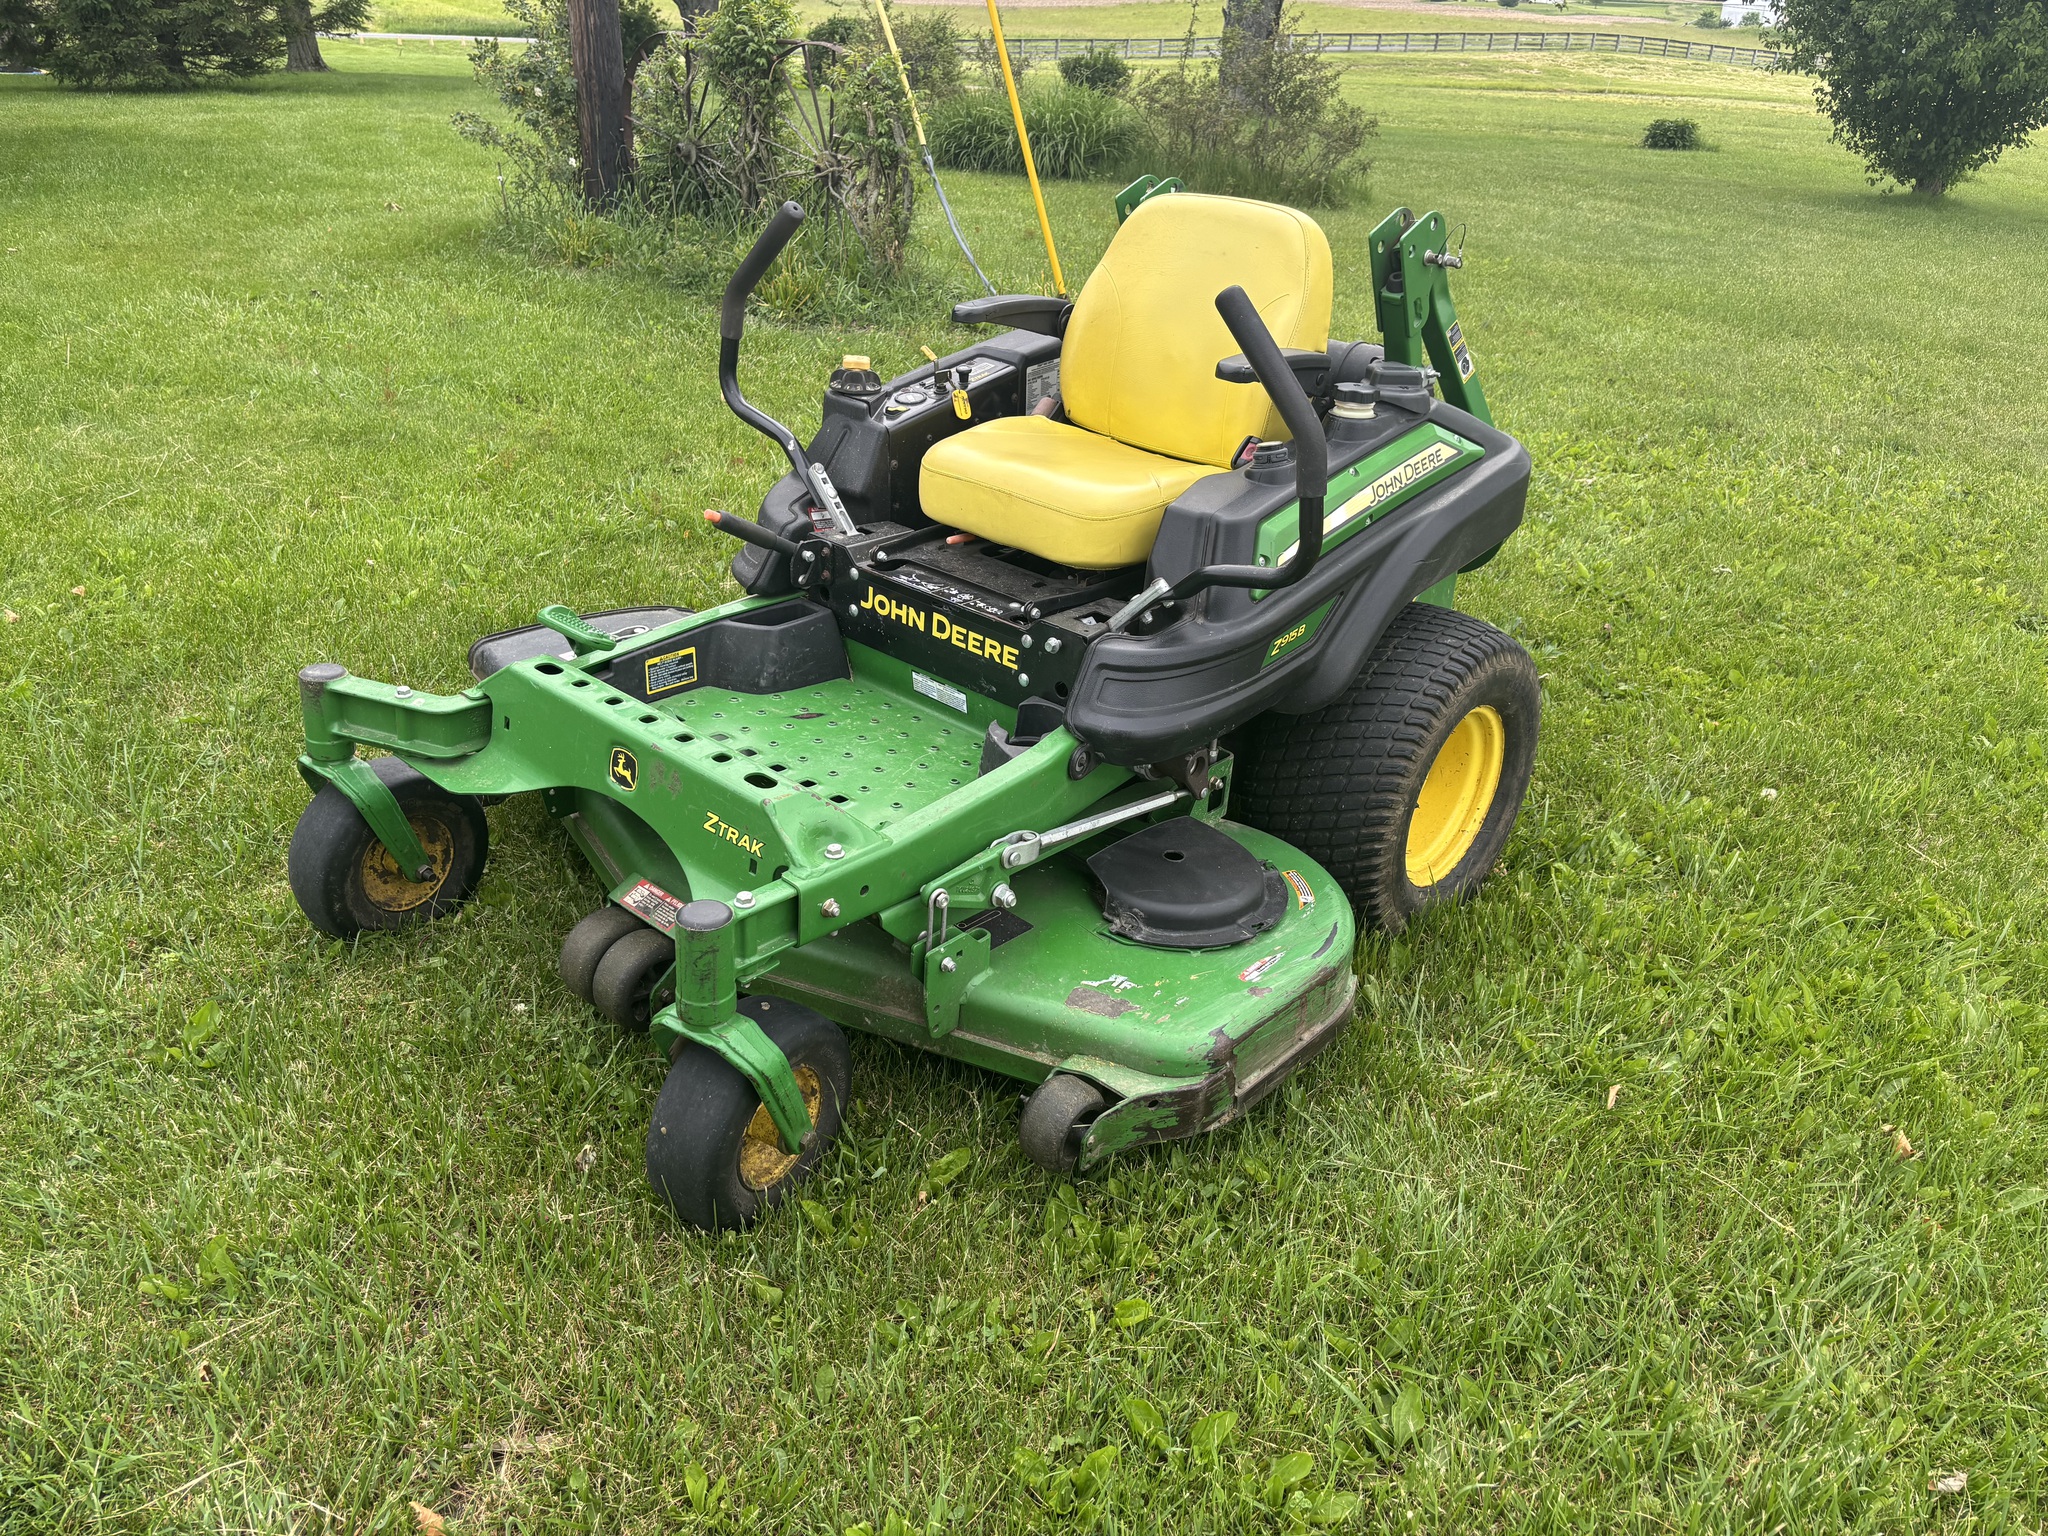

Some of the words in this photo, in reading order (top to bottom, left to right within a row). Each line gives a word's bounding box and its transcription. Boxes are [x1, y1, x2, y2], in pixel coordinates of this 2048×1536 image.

[1369, 472, 1403, 504] JOHN
[1403, 448, 1444, 482] DEERE
[860, 586, 925, 632] JOHN
[932, 612, 1020, 670] DEERE
[1270, 624, 1306, 657] Z915B
[703, 811, 766, 859] ZTRAK
